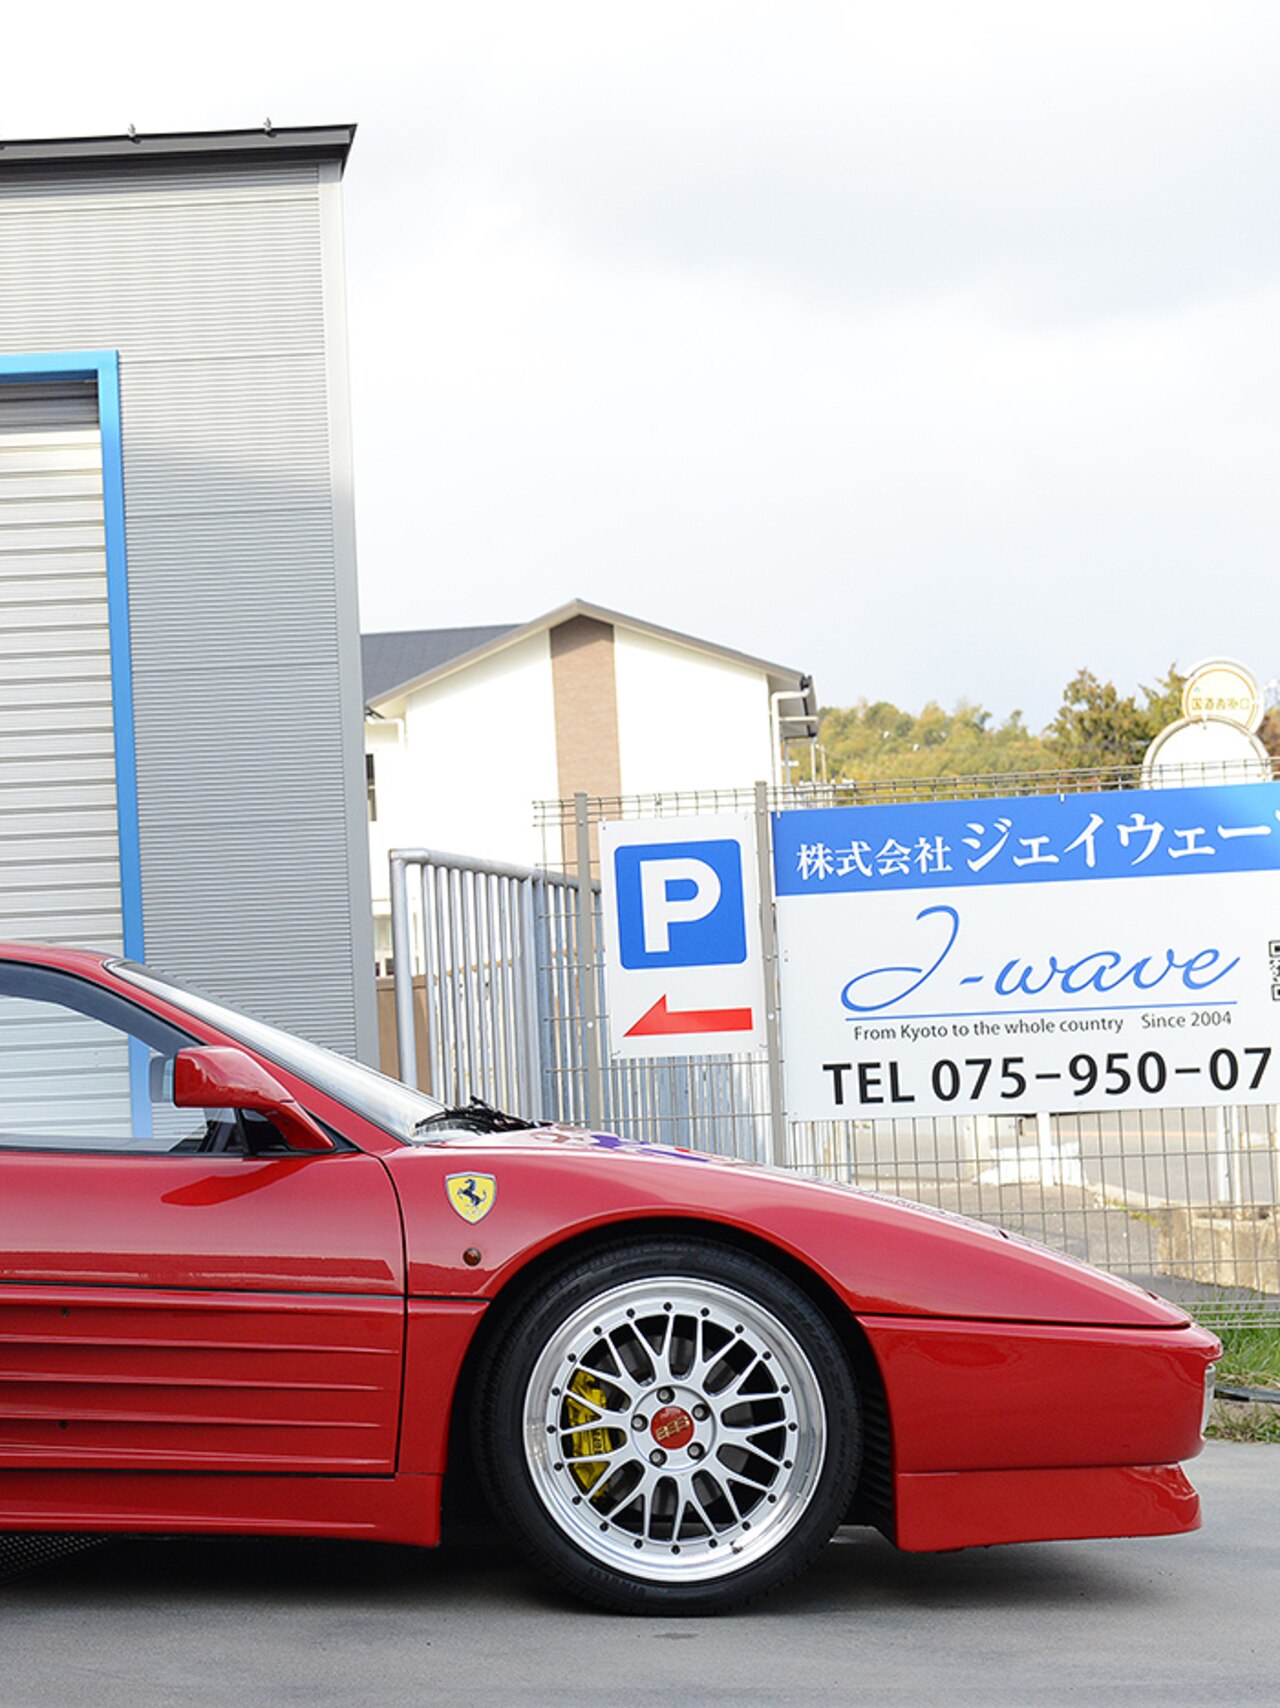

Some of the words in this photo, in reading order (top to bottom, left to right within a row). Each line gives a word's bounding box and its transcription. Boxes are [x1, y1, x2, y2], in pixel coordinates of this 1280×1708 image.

[639, 857, 721, 953] P
[840, 904, 1241, 1012] J-wave
[854, 1026, 897, 1041] From
[900, 1024, 949, 1043] Kyoto
[952, 1023, 970, 1037] to
[973, 1021, 1001, 1036] the
[1004, 1018, 1055, 1035] whole
[1059, 1017, 1124, 1034] country
[1140, 1013, 1186, 1029] Since
[1190, 1010, 1232, 1027] 2004
[822, 1060, 916, 1106] TEL
